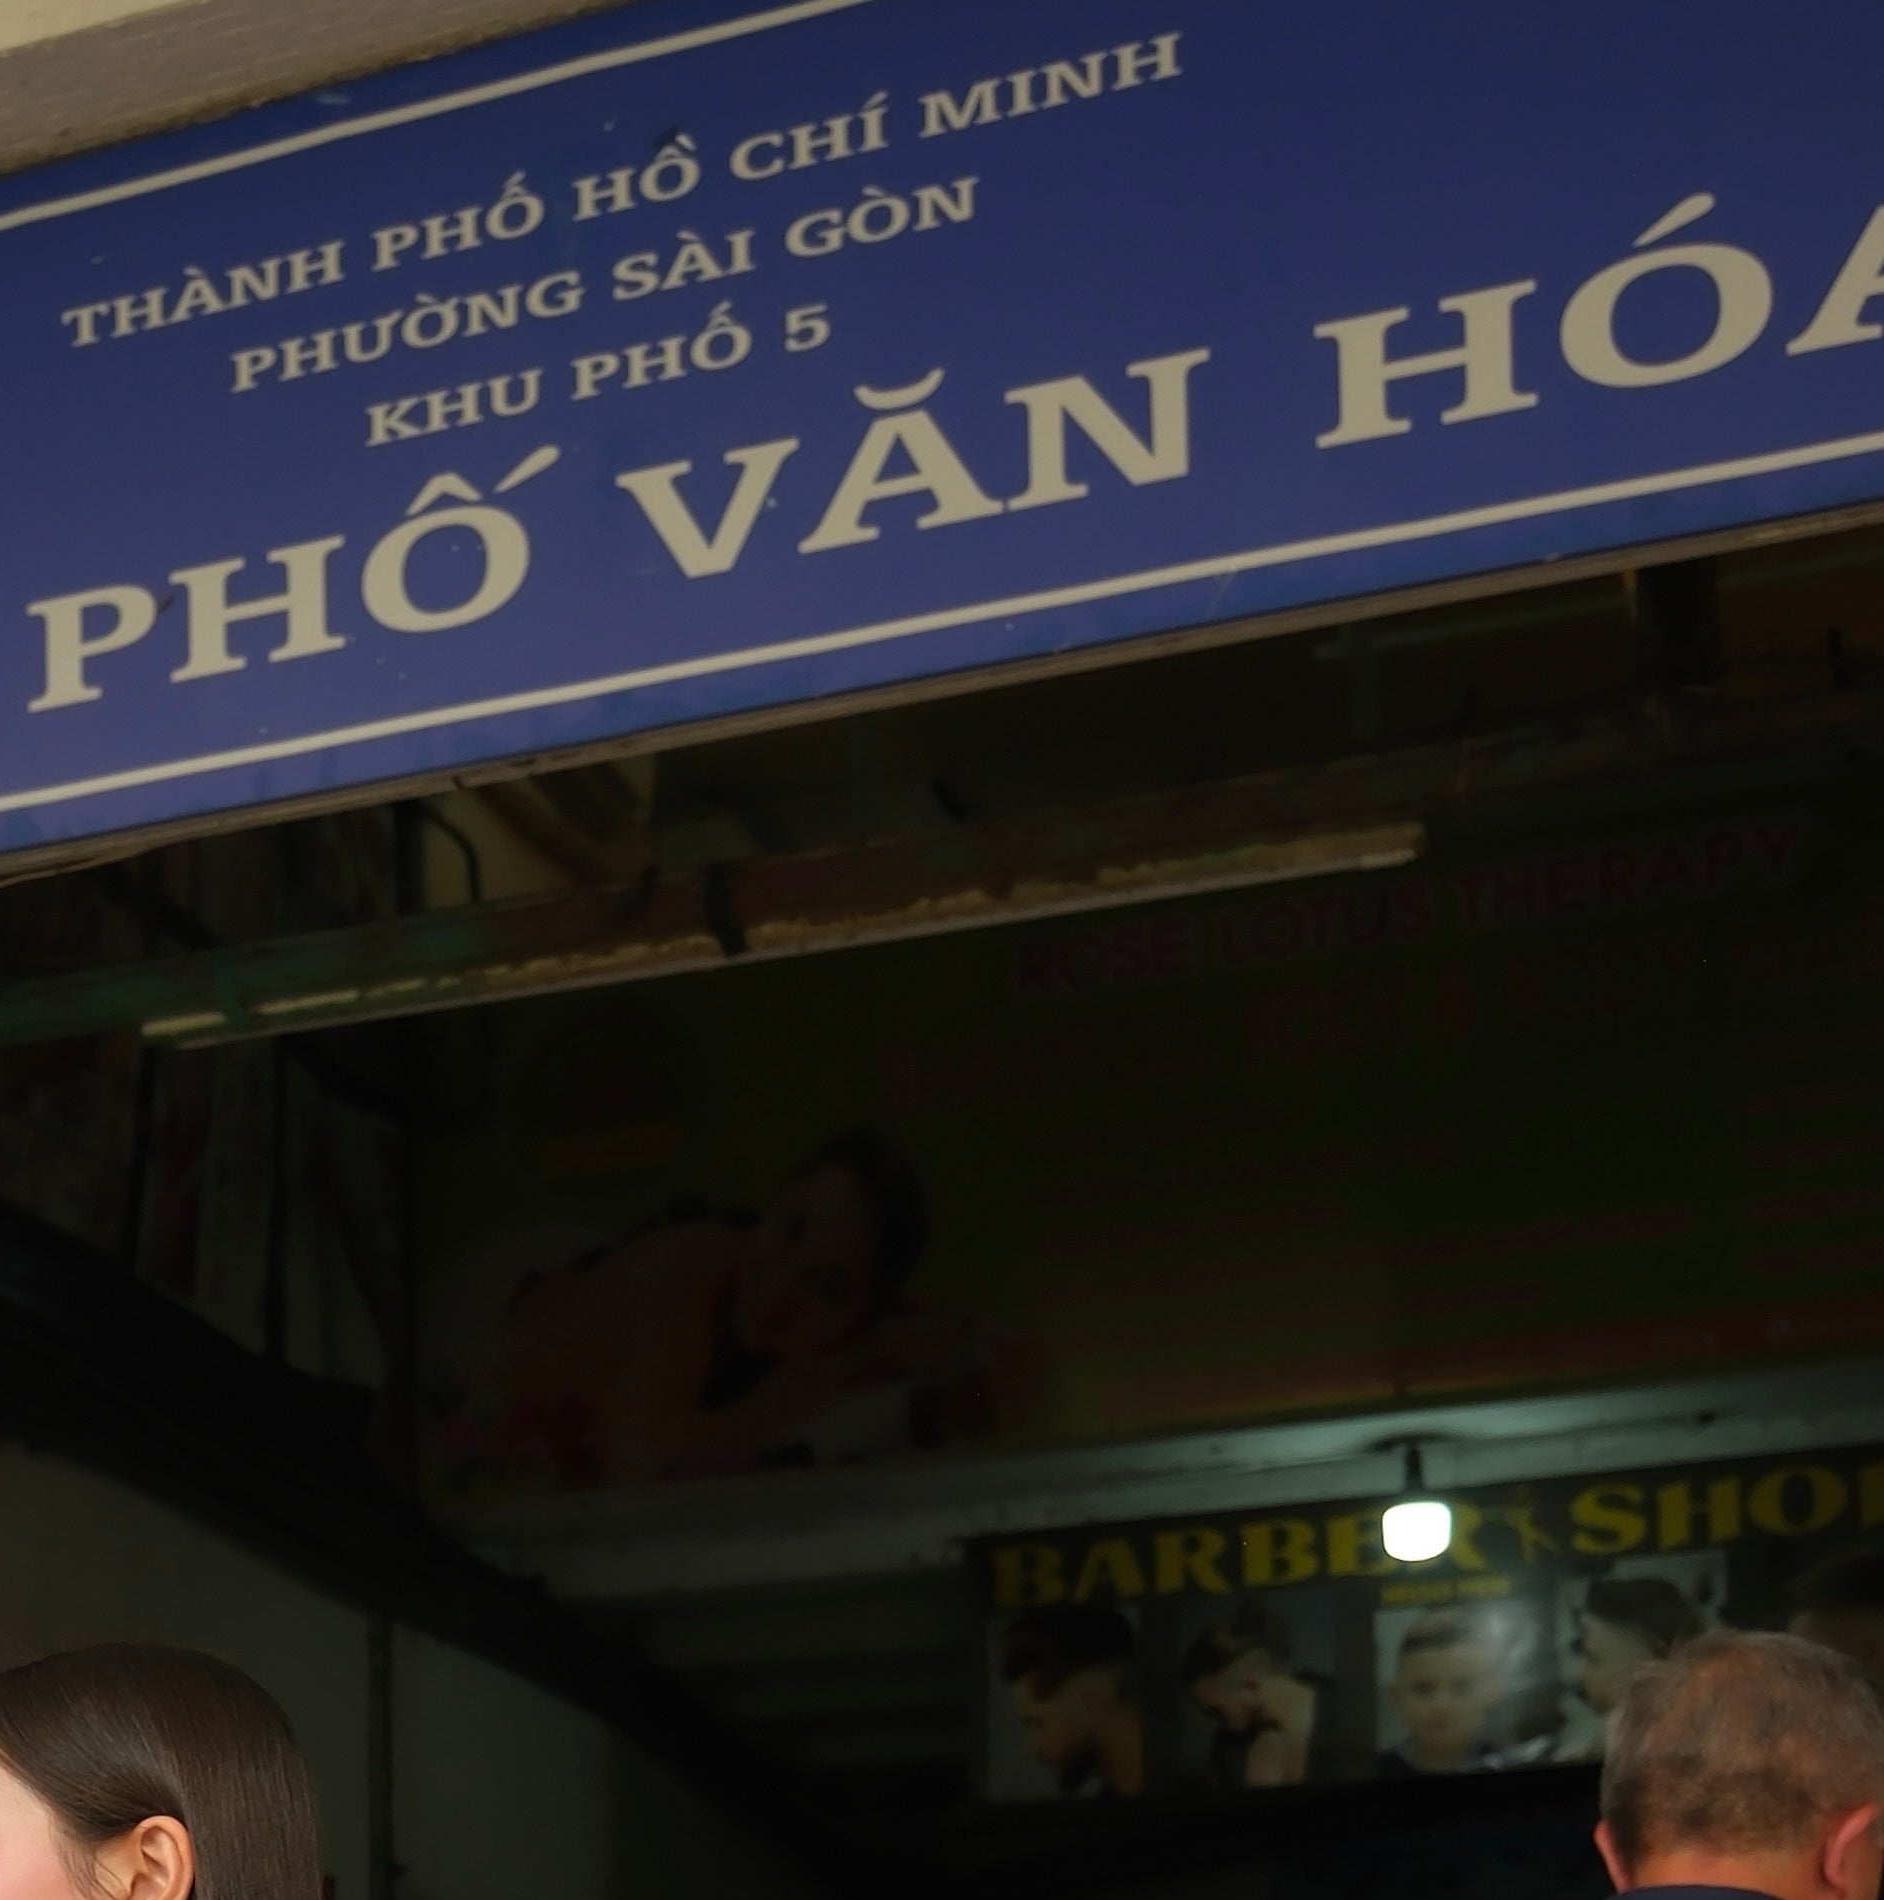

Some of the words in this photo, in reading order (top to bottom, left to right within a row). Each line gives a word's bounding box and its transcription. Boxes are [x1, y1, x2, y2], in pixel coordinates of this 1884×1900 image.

[62, 244, 346, 348] THÀNH
[373, 172, 546, 270] PHỐ
[569, 134, 703, 222] HỒ
[729, 93, 892, 183] CHÍ
[917, 32, 1182, 138] MINH
[229, 270, 585, 394] PHƯỜNG
[612, 228, 756, 305] SÀI
[784, 177, 979, 263] GÒN
[366, 370, 543, 447] KHU
[569, 301, 756, 402] PHỐ
[784, 304, 832, 356] 5
[25, 445, 561, 714] PHỐ
[615, 347, 1211, 579] VĂN
